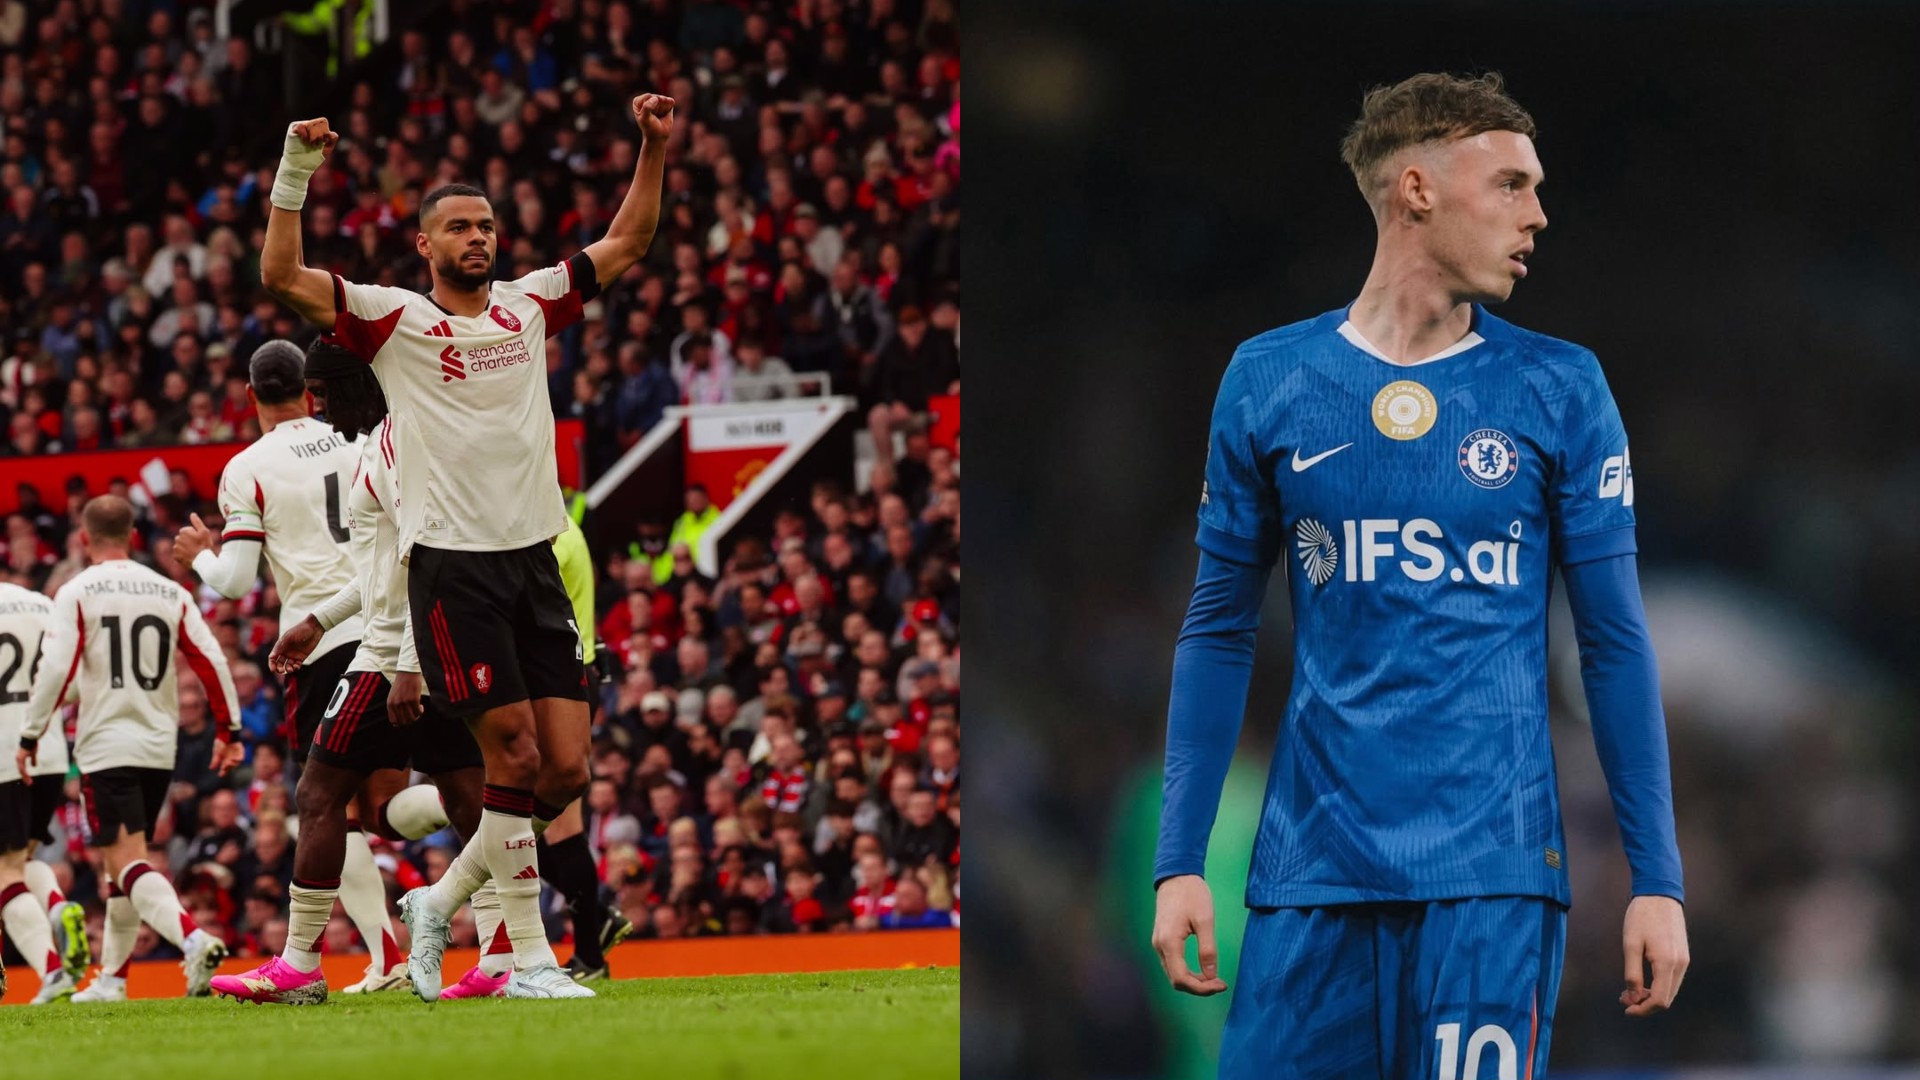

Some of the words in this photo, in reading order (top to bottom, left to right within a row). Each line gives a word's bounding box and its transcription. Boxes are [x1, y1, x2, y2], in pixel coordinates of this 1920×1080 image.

[468, 339, 525, 360] standard
[470, 350, 531, 373] chartered
[1378, 389, 1394, 417] WORLD
[1392, 426, 1415, 435] FIFA
[1469, 431, 1508, 446] CHELSEA
[1468, 472, 1494, 486] FOOTBALL
[1495, 476, 1508, 485] CLUB
[1343, 518, 1522, 585] IFS.ai
[84, 580, 115, 596] MAC
[118, 581, 178, 600] ALLISTER
[101, 614, 171, 691] 10
[505, 839, 535, 850] LFC
[1435, 1022, 1517, 1080] 10
